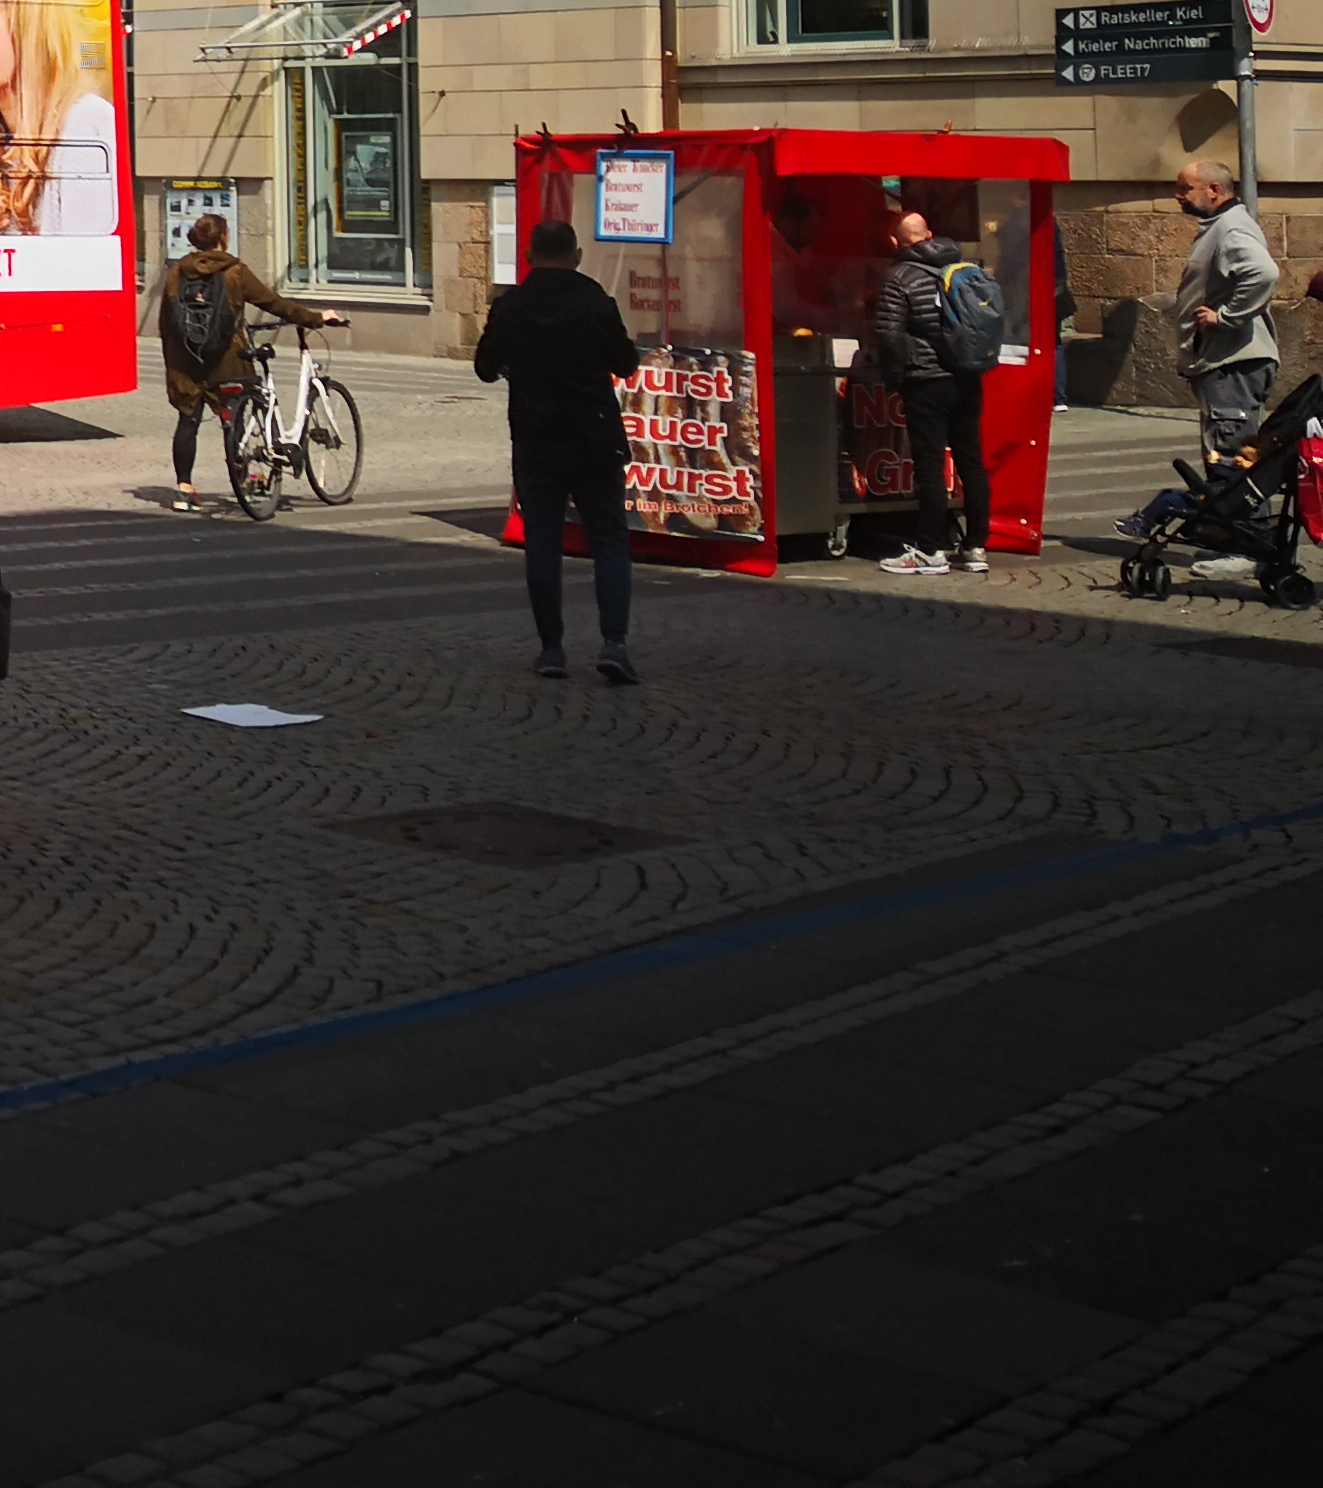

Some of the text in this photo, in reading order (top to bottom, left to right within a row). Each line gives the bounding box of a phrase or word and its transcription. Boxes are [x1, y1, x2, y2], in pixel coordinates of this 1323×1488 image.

[1101, 6, 1204, 25] Ratskeller Kiel
[1078, 35, 1210, 53] Kieler Nachrichten
[1101, 65, 1151, 78] FLEET7
[605, 178, 643, 192] Bratwurst
